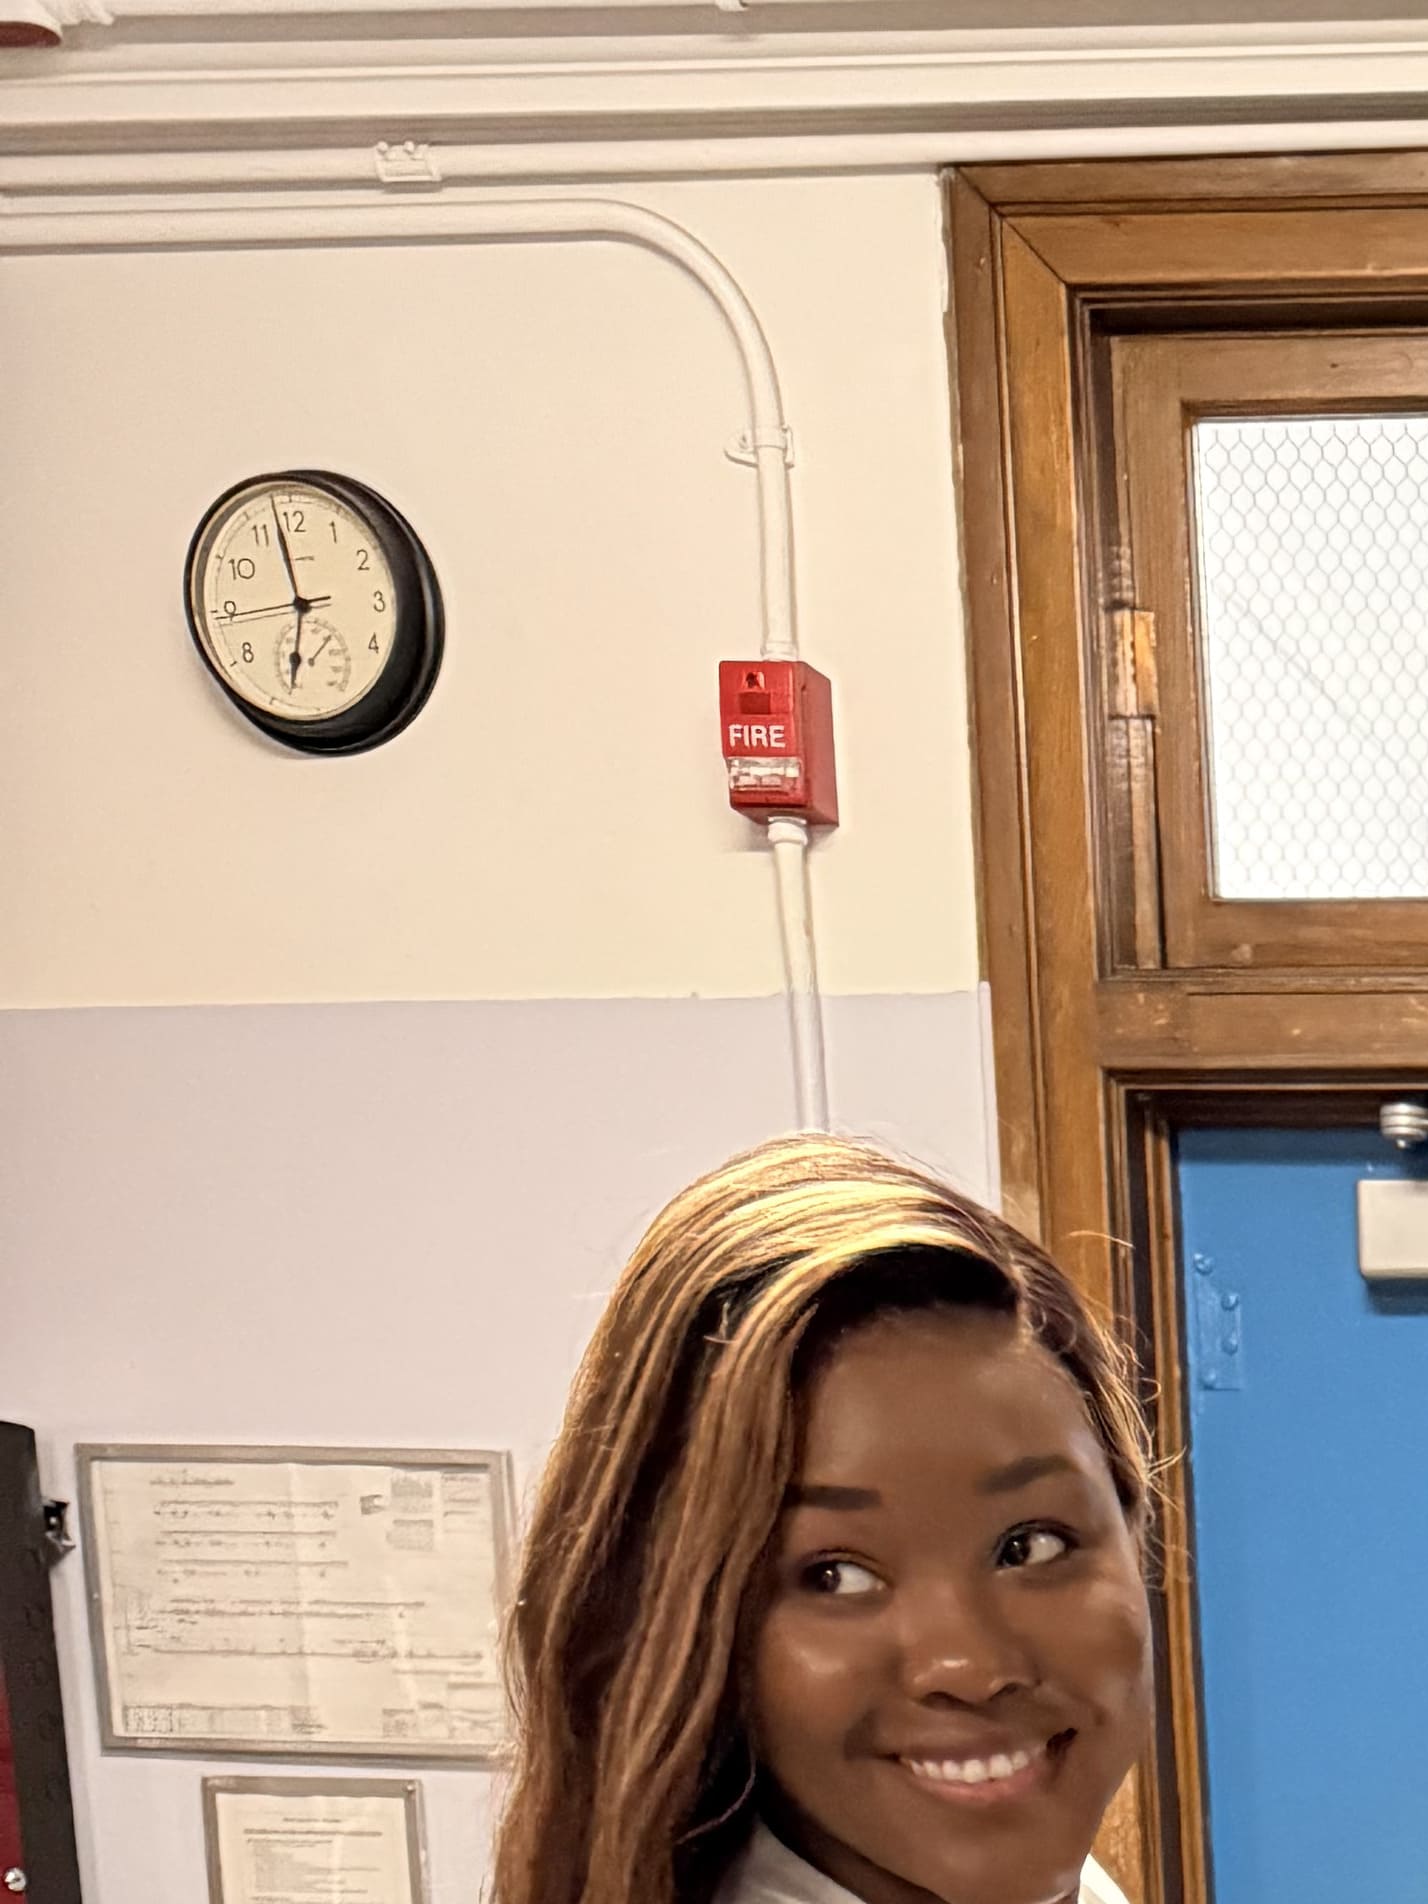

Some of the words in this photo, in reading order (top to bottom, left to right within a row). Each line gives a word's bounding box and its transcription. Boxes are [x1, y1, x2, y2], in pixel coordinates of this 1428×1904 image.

[283, 510, 307, 533] 12
[329, 521, 337, 544] 1
[252, 523, 270, 548] 11
[228, 558, 256, 580] 10
[356, 549, 370, 571] 2
[224, 600, 237, 622] 9
[373, 591, 386, 613] 3
[242, 641, 254, 664] 8
[368, 632, 380, 654] 4
[728, 723, 786, 748] FIRE
